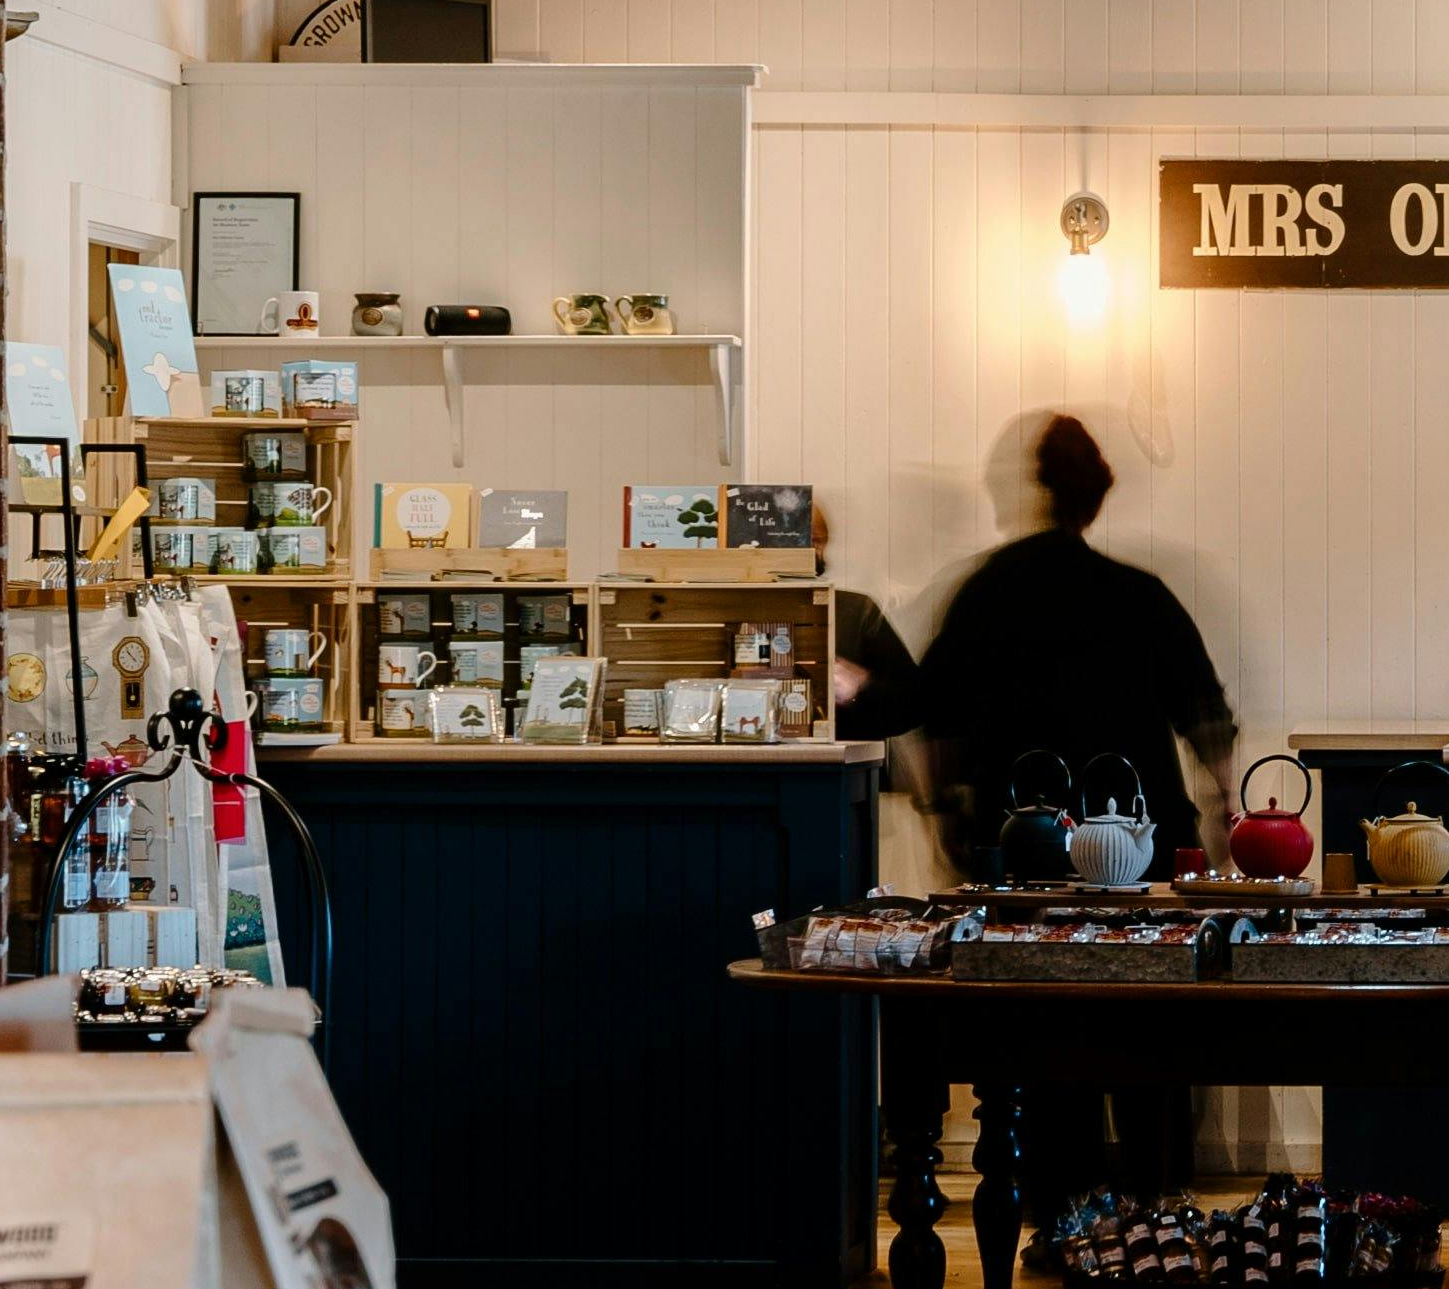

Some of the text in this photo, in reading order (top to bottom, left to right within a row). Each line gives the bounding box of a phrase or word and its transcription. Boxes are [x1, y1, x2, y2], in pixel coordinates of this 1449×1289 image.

[1192, 182, 1346, 259] MRS
[412, 504, 436, 512] HALF
[747, 501, 769, 512] Glad
[410, 513, 436, 523] FULL
[759, 516, 776, 527] Life
